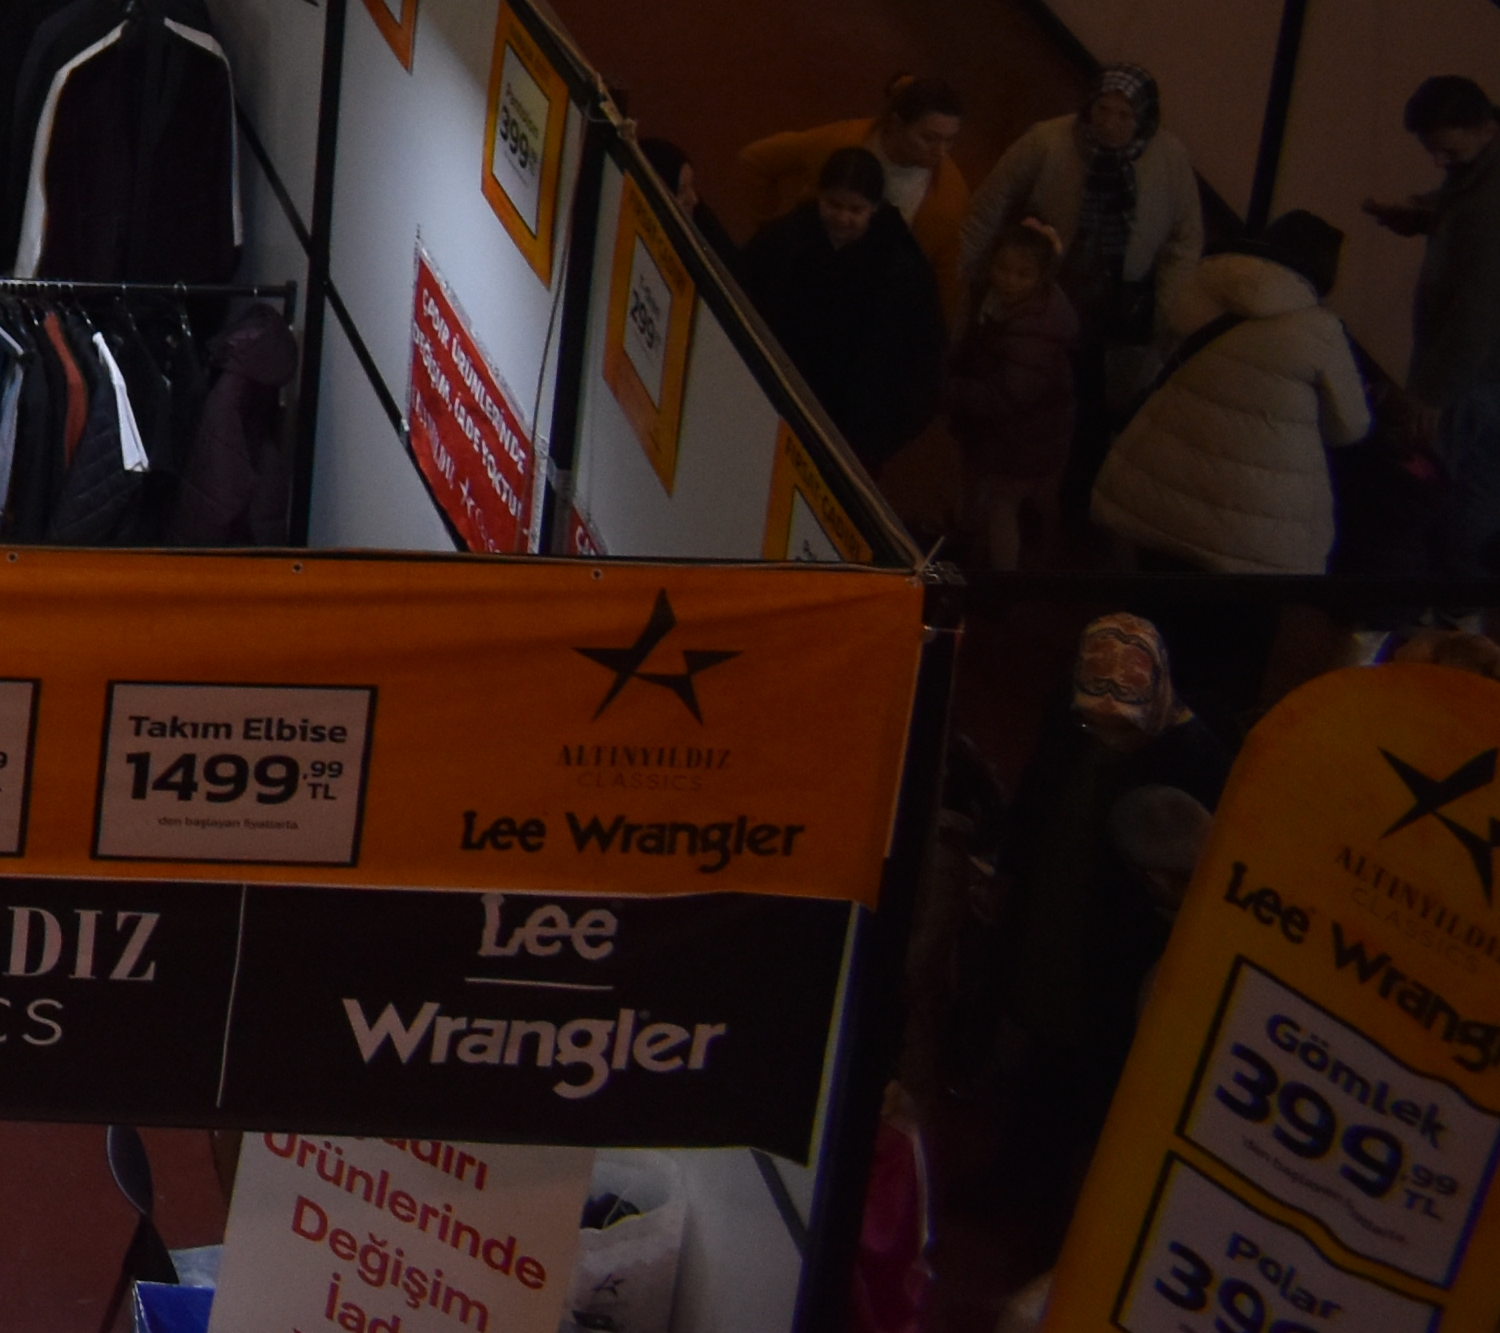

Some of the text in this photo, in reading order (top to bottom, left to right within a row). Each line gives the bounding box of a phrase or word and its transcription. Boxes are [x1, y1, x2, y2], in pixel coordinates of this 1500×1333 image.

[128, 715, 348, 743] Takım Elbise
[556, 743, 732, 770] ALTINYILDIZ
[307, 782, 337, 802] TL
[577, 773, 702, 792] CLASSICS
[461, 810, 805, 873] Lee Wrangler
[478, 891, 621, 964] Lee
[1225, 861, 1310, 944] Lee
[341, 997, 727, 1100] Wrangler
[1265, 1013, 1448, 1150] Gömlek
[1405, 1188, 1440, 1221] TL
[292, 1194, 488, 1333] Değişim
[1226, 1232, 1342, 1321] Polar
